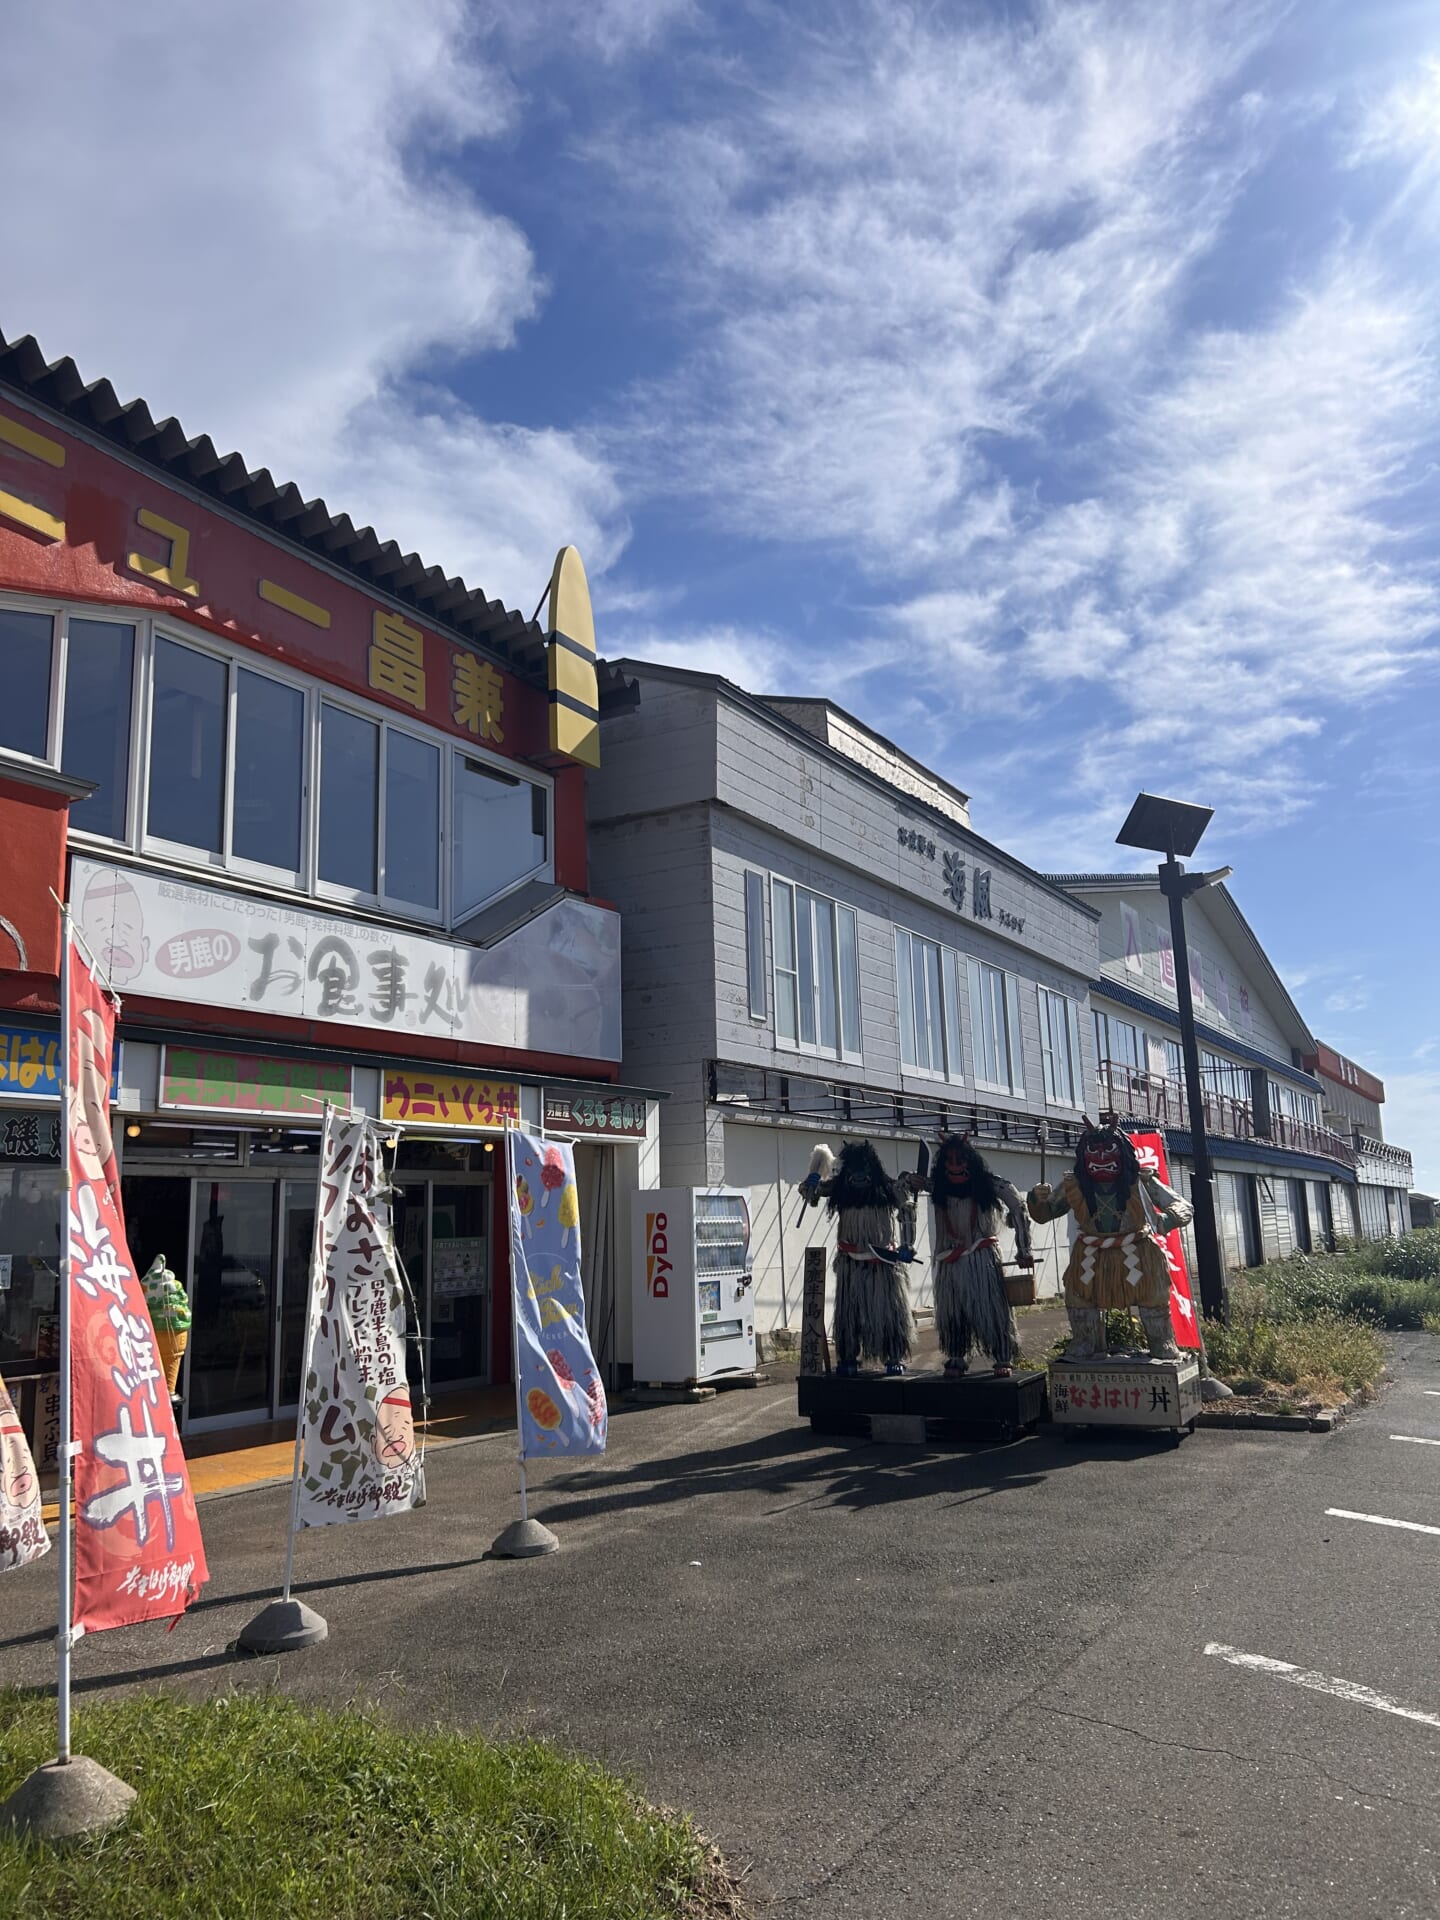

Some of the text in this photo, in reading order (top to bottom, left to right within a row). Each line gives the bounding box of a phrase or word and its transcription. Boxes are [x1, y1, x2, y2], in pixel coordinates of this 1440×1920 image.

[168, 932, 471, 1031] 男鹿の お食事処
[386, 1075, 518, 1125] ウニいくら丼
[350, 1283, 375, 1384] ブレンド粉末
[370, 1279, 397, 1386] 男鹿半島の塩
[1054, 1383, 1069, 1413] 海鮮
[1069, 1383, 1148, 1409] なまはげ
[1147, 1386, 1171, 1413] 丼
